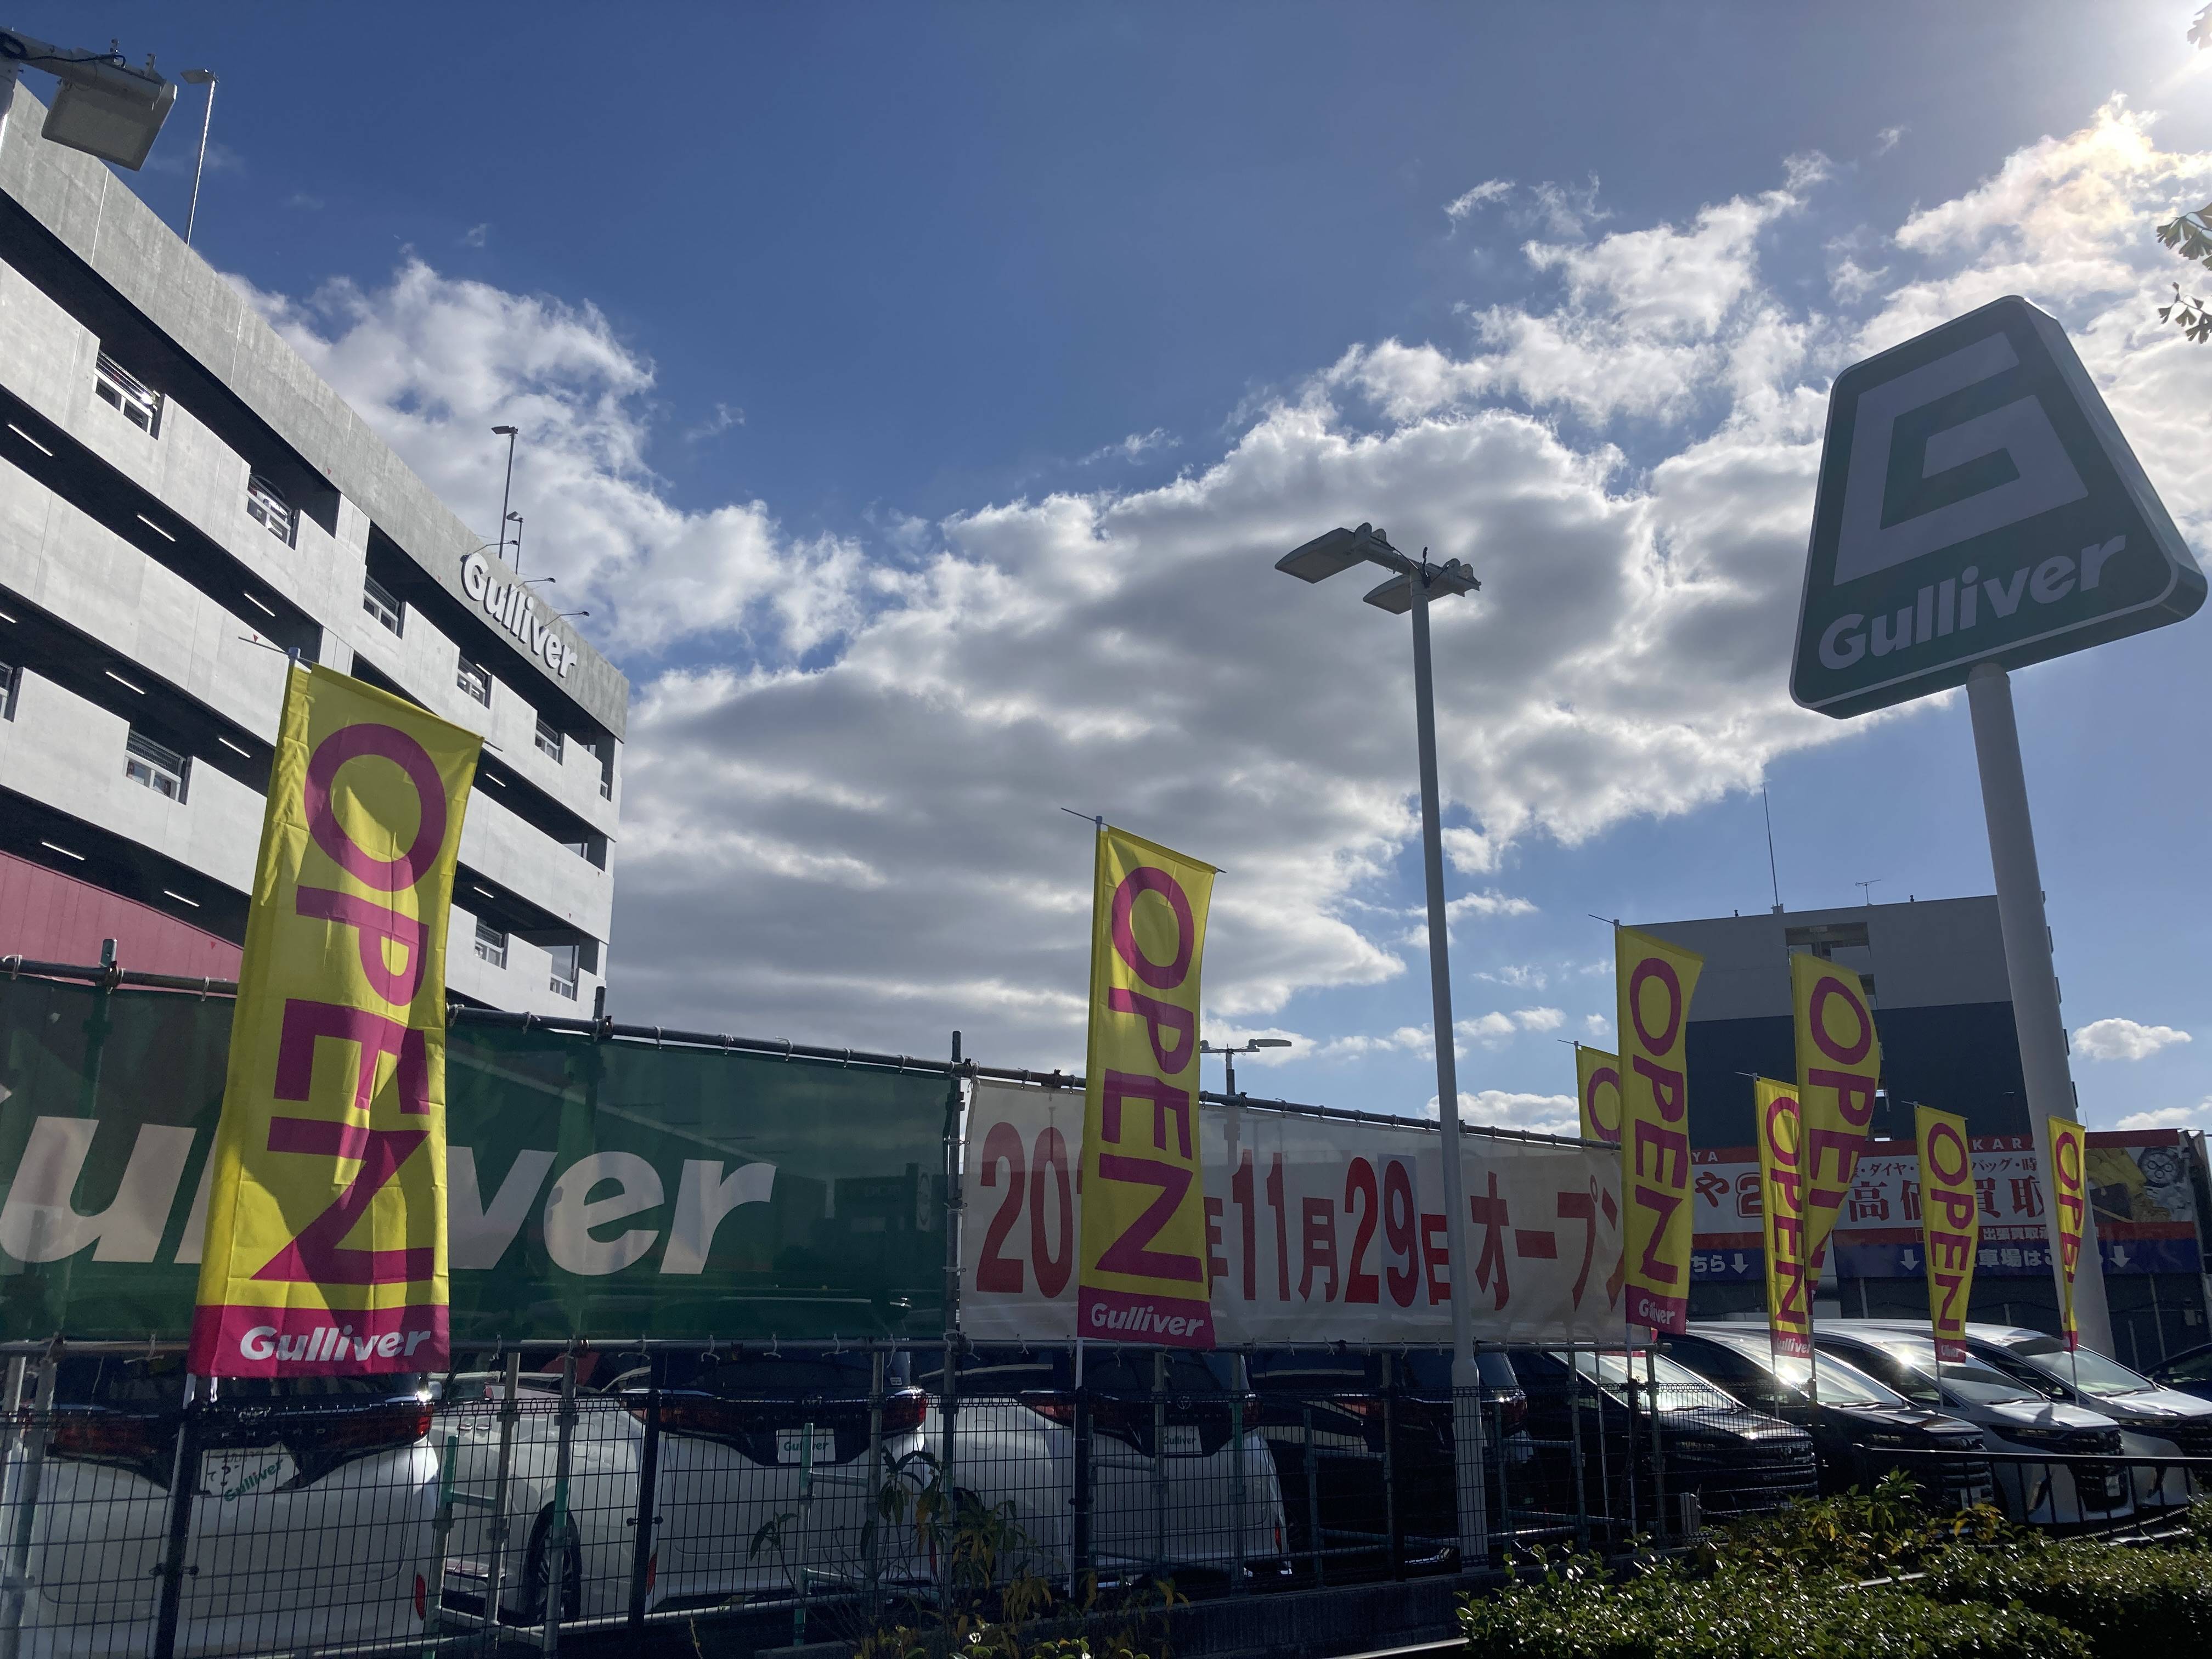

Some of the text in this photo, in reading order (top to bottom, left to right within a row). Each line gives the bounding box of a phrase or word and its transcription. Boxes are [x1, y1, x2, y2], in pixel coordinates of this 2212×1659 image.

[461, 552, 578, 679] Gulliver
[1819, 535, 2126, 670] Gulliver
[250, 723, 447, 1285] OPEN
[1094, 867, 1203, 1282] OPEN
[1630, 958, 1688, 1284] OPEN
[1926, 1122, 1975, 1331] OPEN
[240, 1325, 431, 1362] Gulliver
[1091, 1302, 1204, 1337] Gulliver
[223, 1458, 284, 1502] Gulliver
